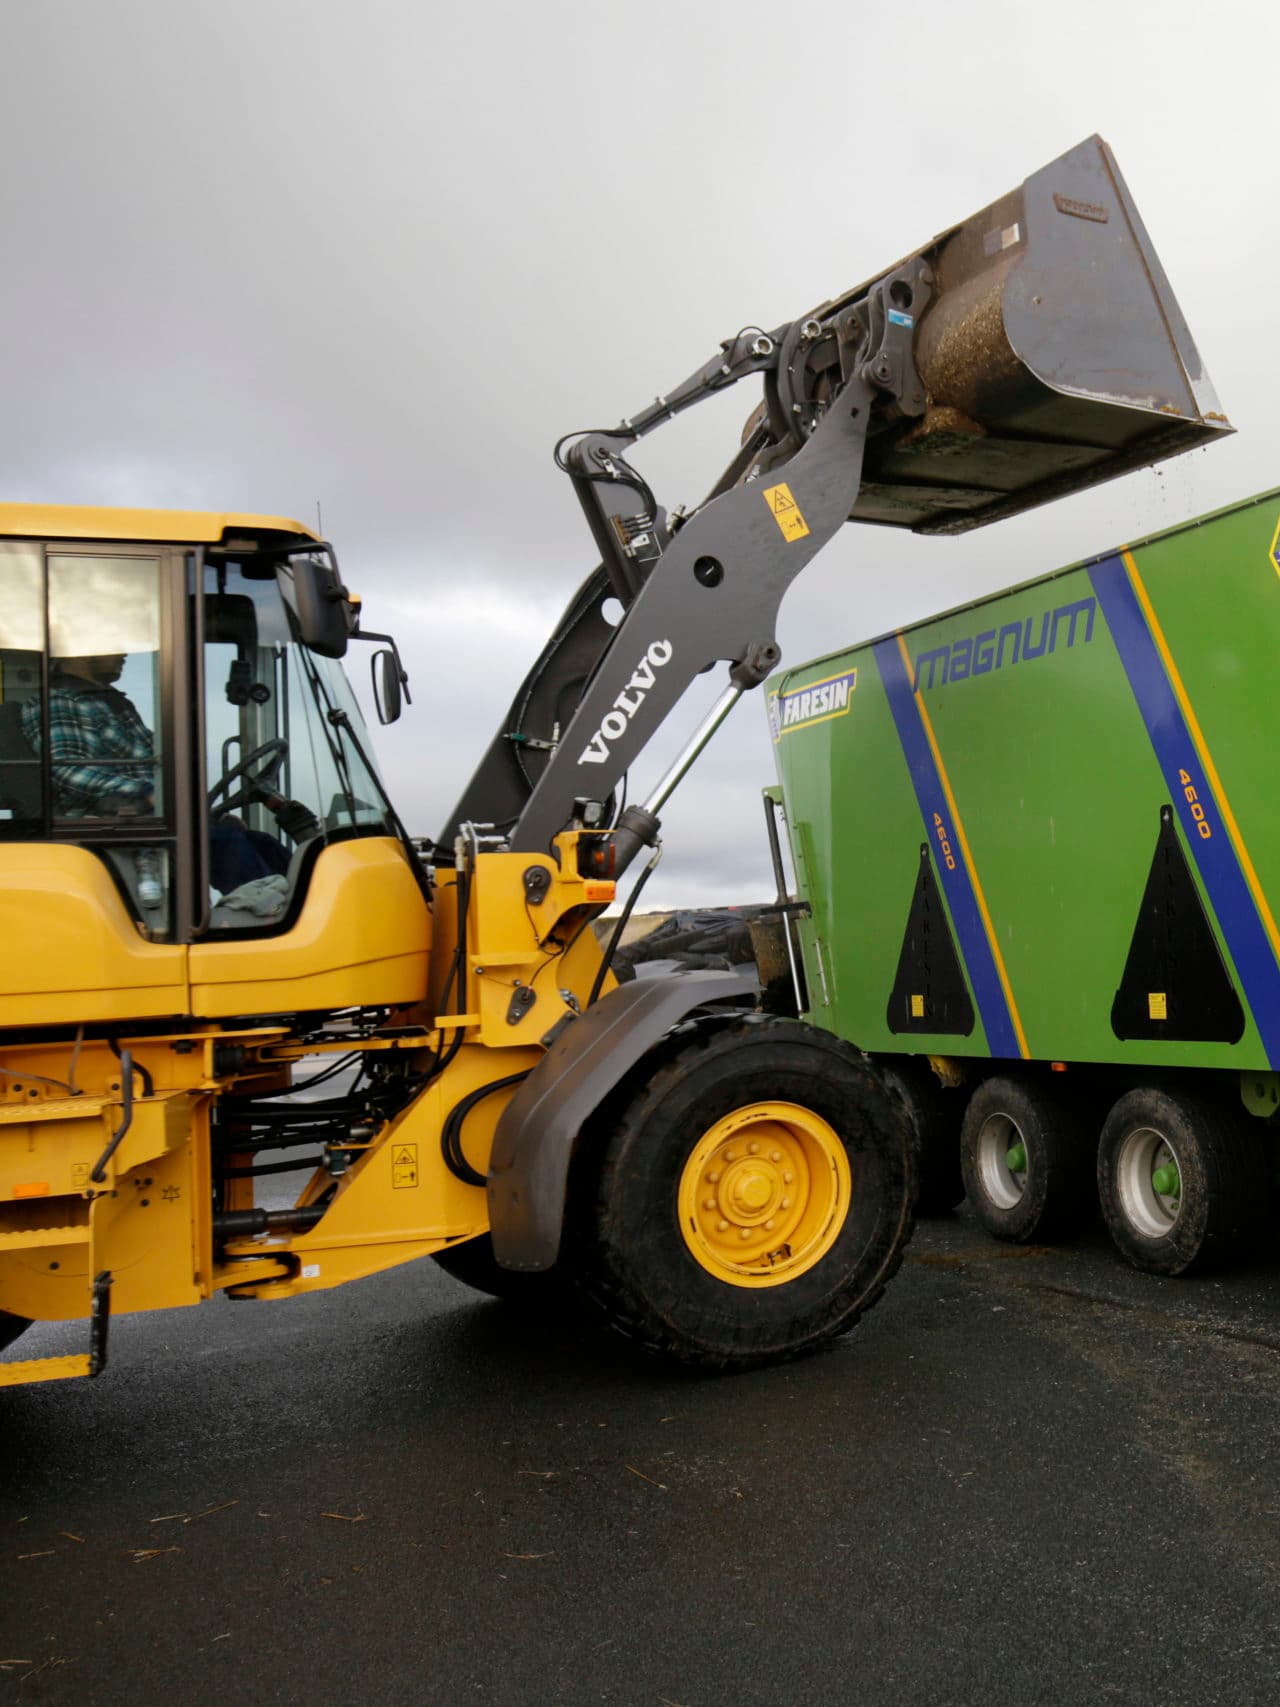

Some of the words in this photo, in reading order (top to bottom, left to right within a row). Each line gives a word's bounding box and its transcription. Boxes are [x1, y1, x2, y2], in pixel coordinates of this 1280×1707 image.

[577, 639, 673, 765] VOLVO
[783, 679, 849, 726] FARESIN
[1178, 768, 1212, 839] 4600
[933, 812, 956, 870] 4600
